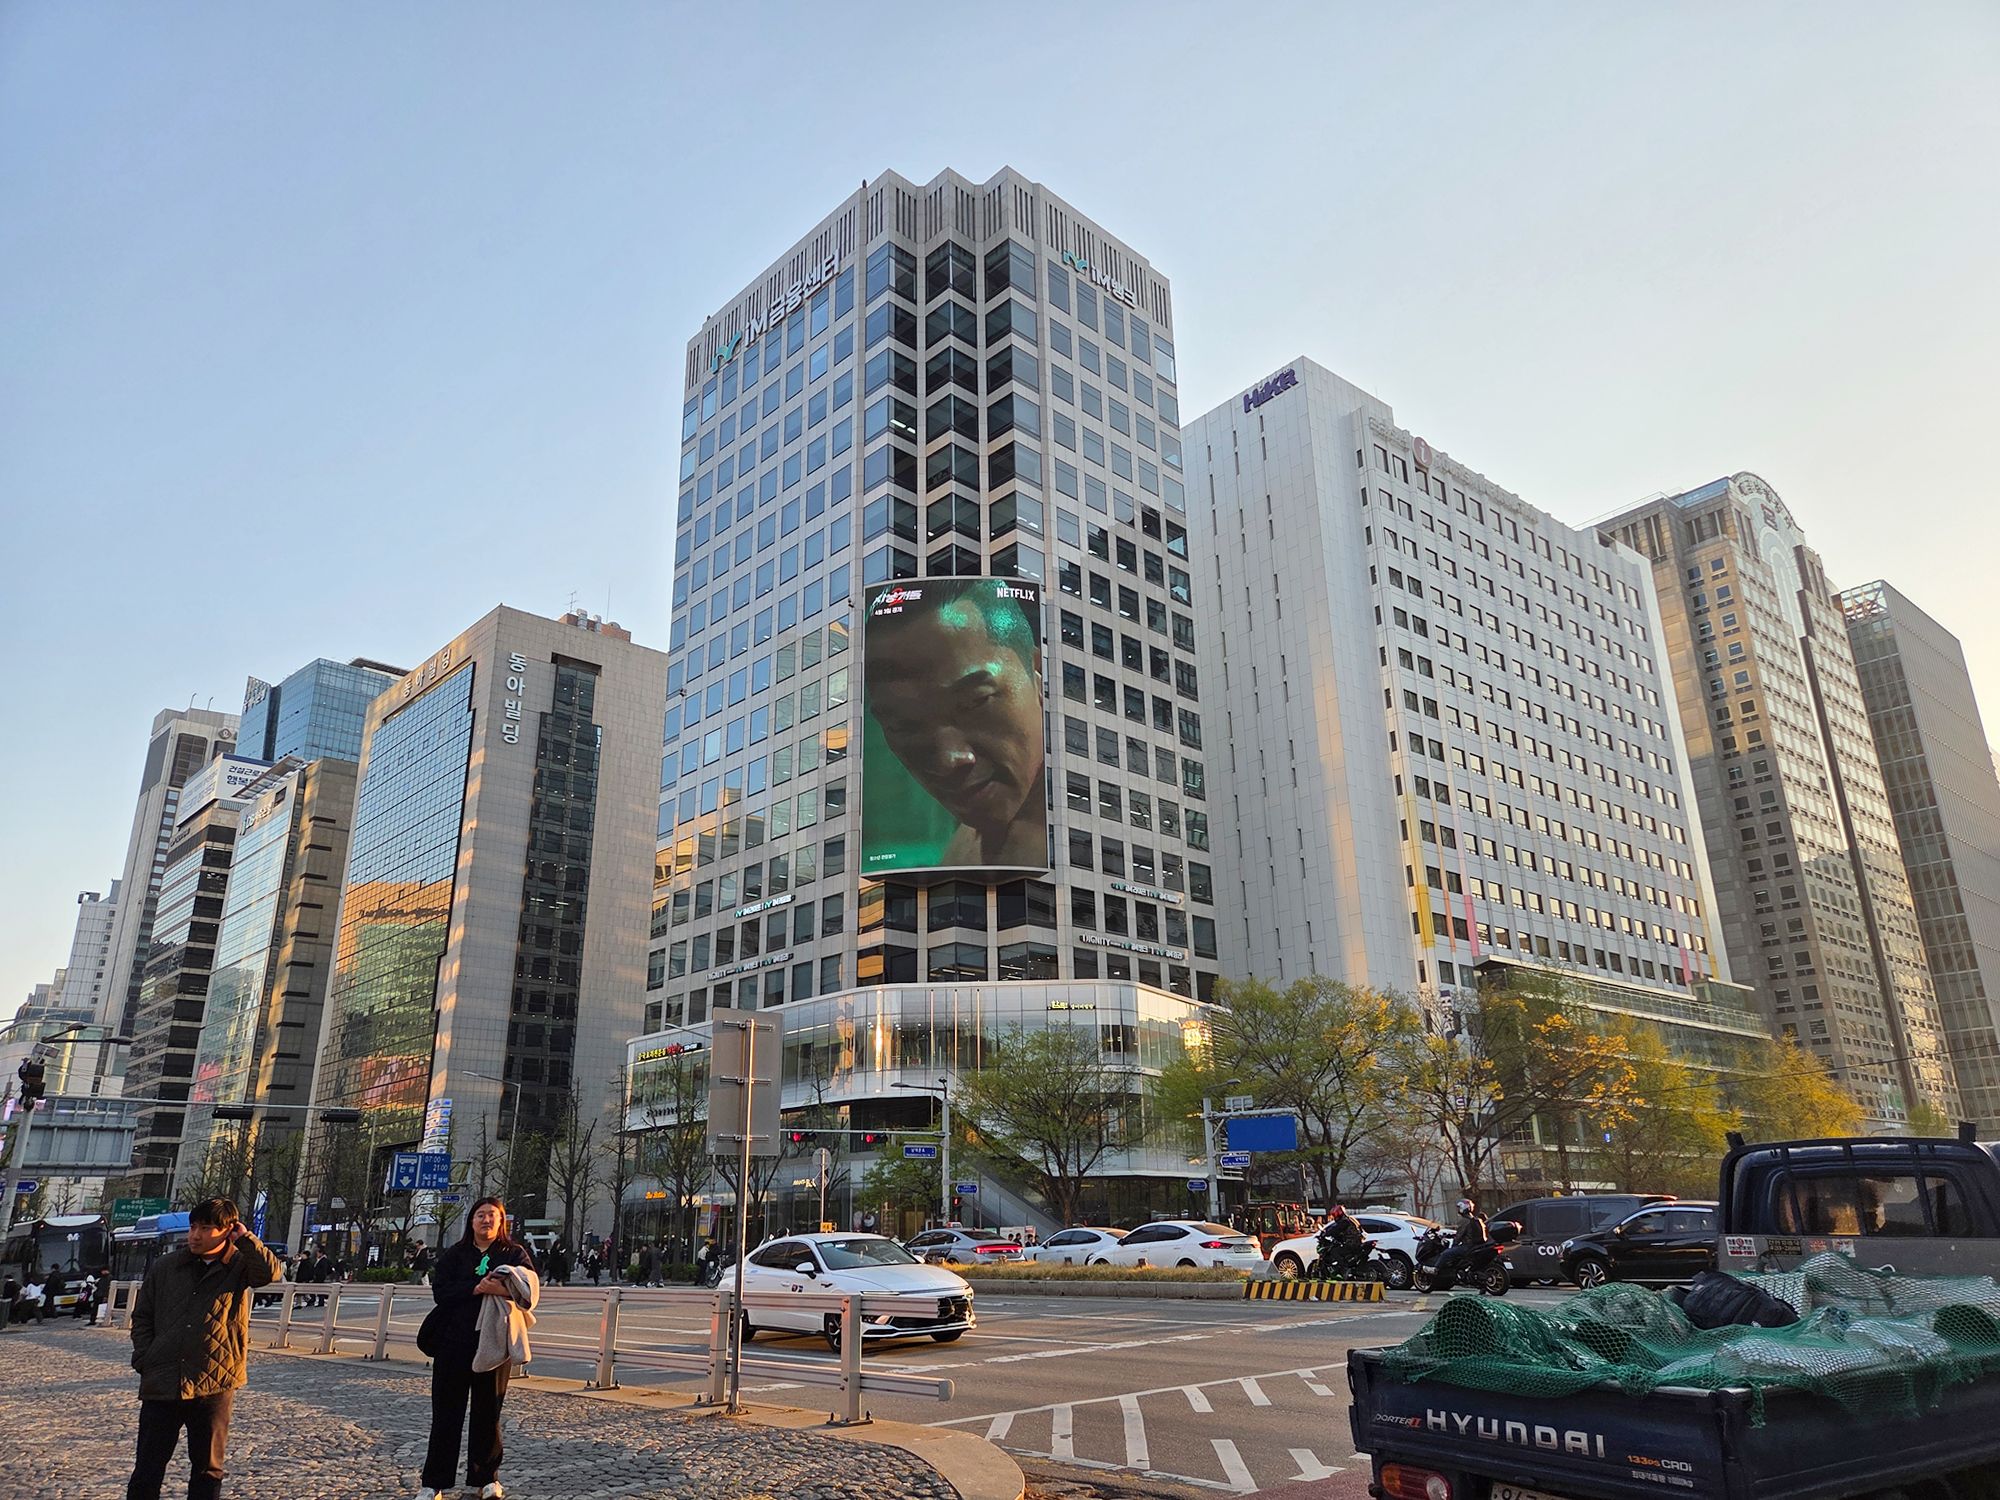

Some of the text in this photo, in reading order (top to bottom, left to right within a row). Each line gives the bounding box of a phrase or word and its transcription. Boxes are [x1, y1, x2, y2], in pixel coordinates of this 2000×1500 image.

[744, 248, 839, 348] iM금융센터
[1090, 264, 1136, 310] iM뱅크
[996, 587, 1035, 602] NETFLIX
[402, 648, 451, 699] 동아빌딩
[501, 651, 528, 744] 동아빌딩
[1082, 934, 1111, 947] DIGNITY
[1426, 1408, 1606, 1458] HYUNDAI
[1661, 1459, 1693, 1472] CRDi
